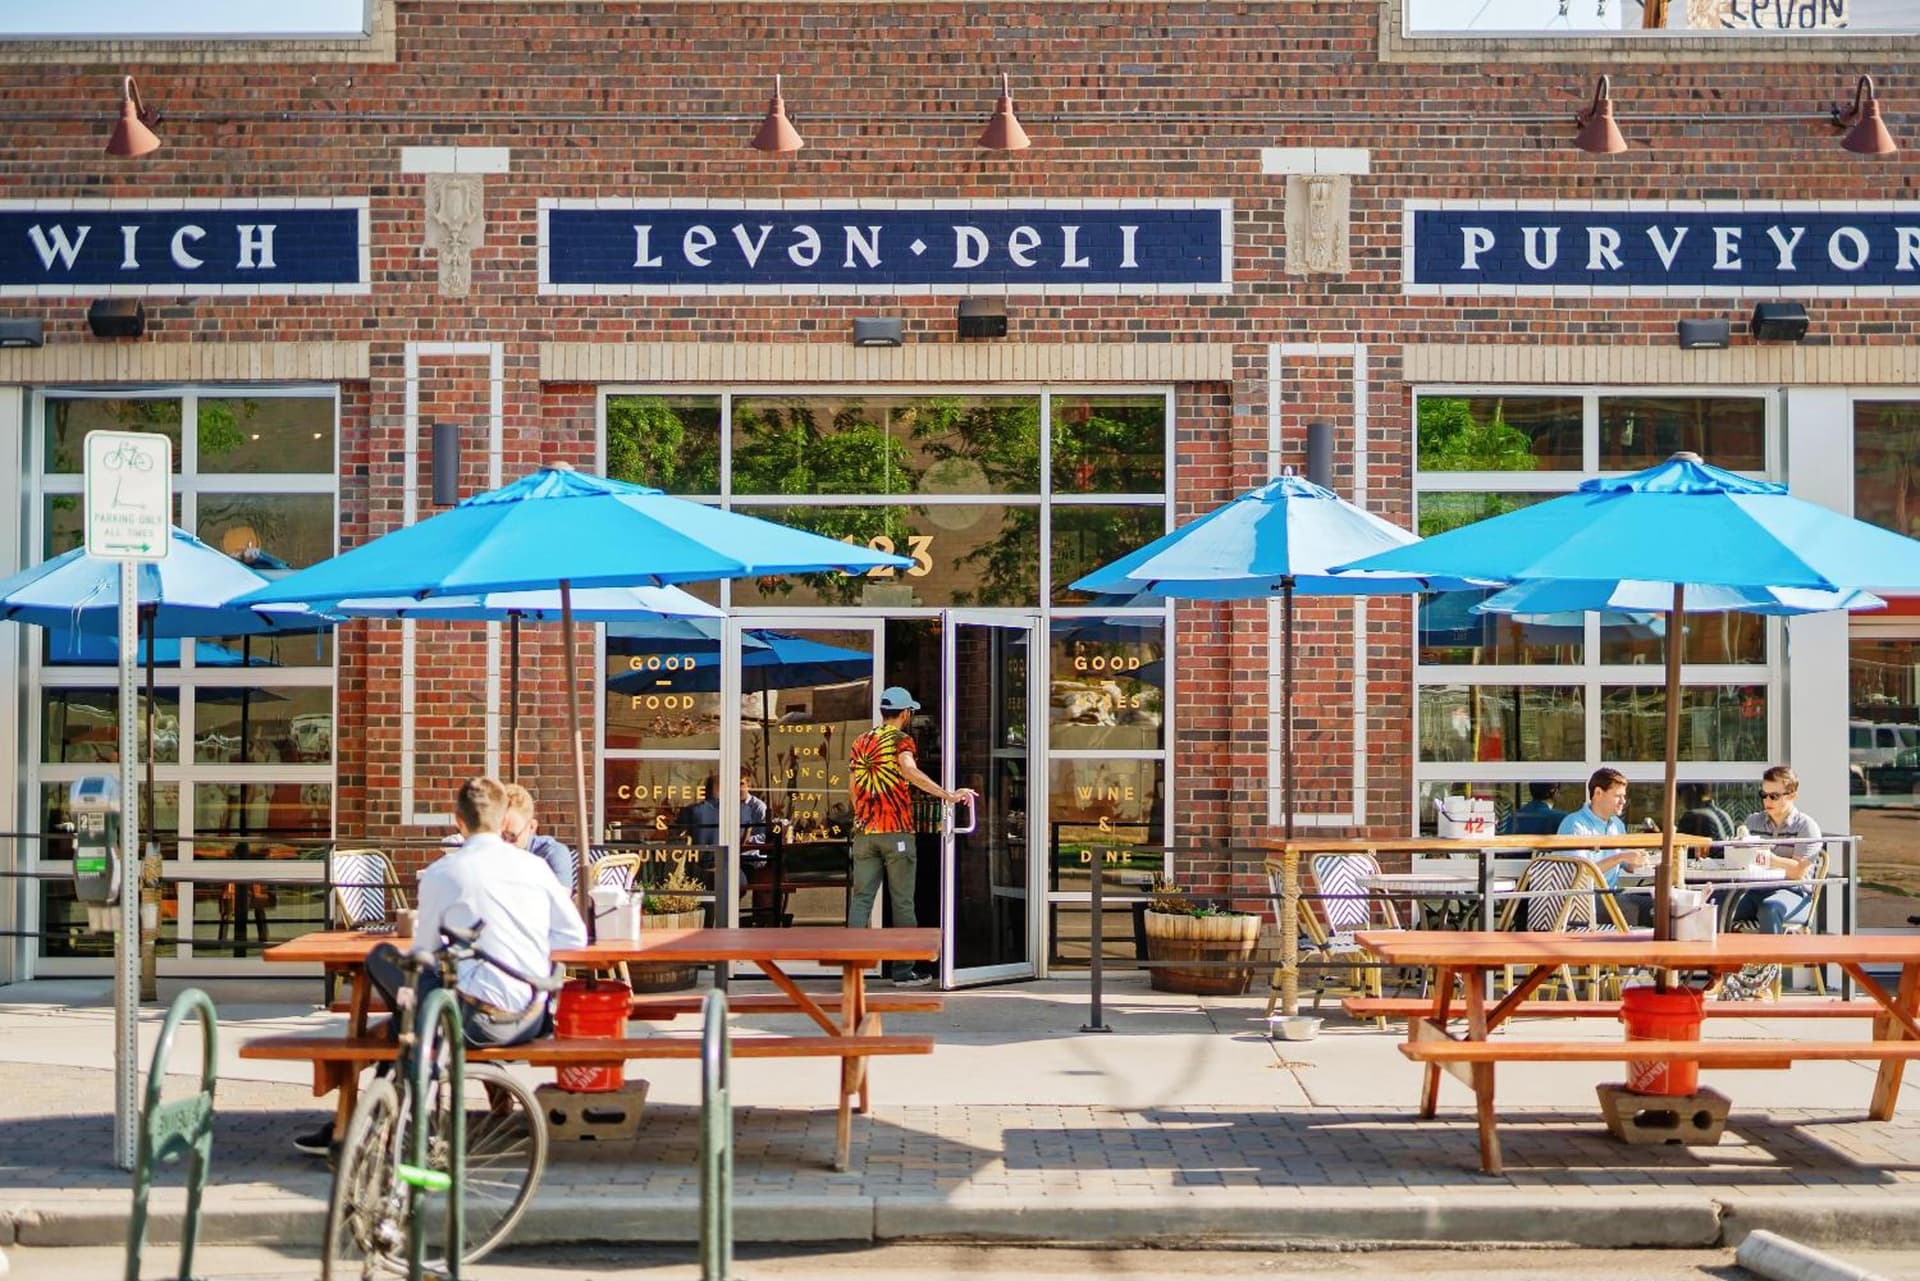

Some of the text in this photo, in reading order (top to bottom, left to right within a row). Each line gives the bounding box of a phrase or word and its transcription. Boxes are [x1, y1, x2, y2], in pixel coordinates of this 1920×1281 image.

[27, 224, 278, 271] WICH
[952, 225, 1139, 268] DeLI
[1460, 225, 1920, 270] PURVEYOR
[94, 512, 135, 524] PARKING
[838, 535, 934, 576] 23
[629, 656, 696, 670] GOOD
[1074, 656, 1140, 670] GOOD
[631, 696, 694, 709] FOOD
[779, 725, 836, 733] STOP BY
[793, 747, 820, 756] FOR
[772, 767, 840, 785] LUNCH
[618, 785, 706, 800] COFFEE
[791, 793, 822, 801] STAY
[1077, 786, 1134, 801] WINE
[793, 811, 819, 819] FOR
[655, 815, 668, 830] &
[1099, 816, 1112, 832] &
[625, 849, 699, 863] UNCH
[1080, 849, 1132, 863] DNE
